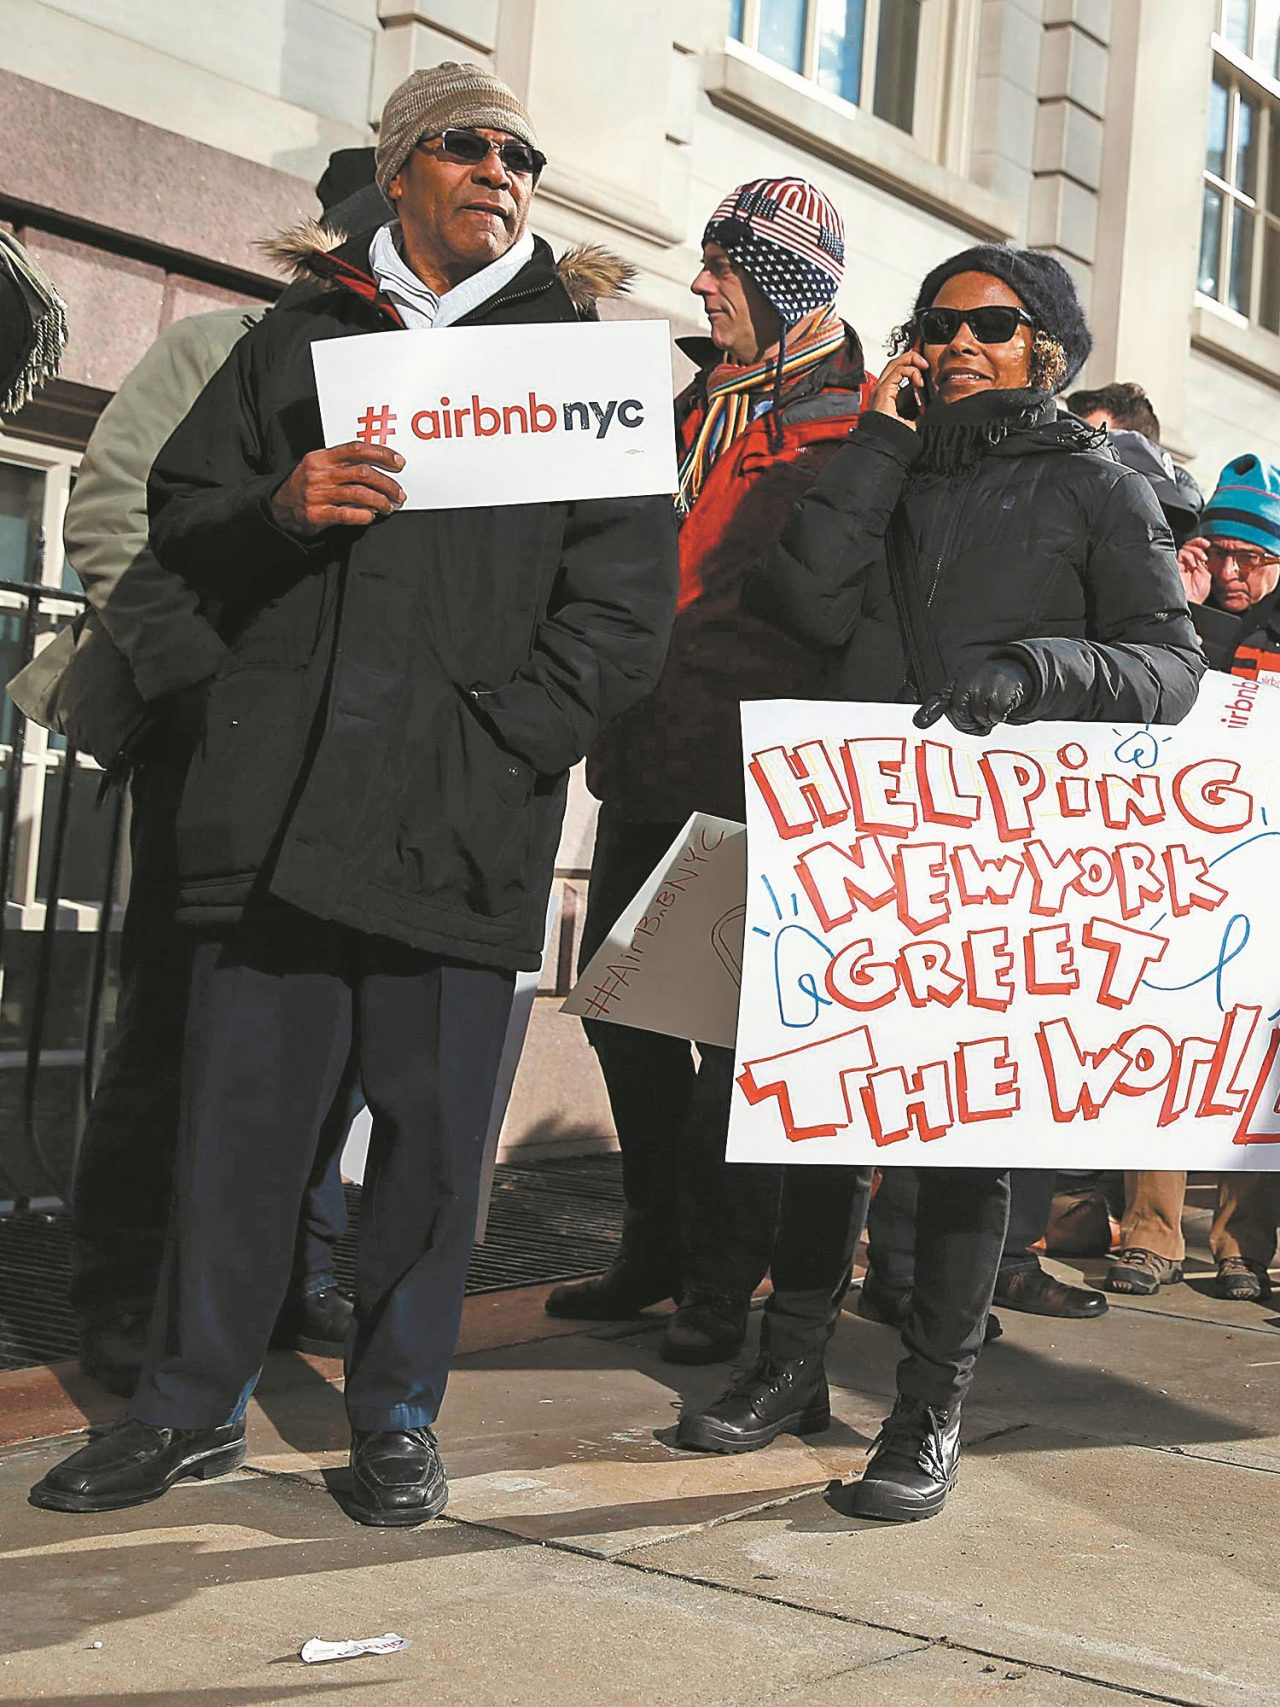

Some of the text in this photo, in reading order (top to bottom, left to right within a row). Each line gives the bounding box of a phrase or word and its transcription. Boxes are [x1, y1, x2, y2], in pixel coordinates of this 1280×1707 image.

[1220, 681, 1260, 728] irbnb
[824, 916, 1170, 1013] GREET
[736, 1024, 1022, 1146] THE
